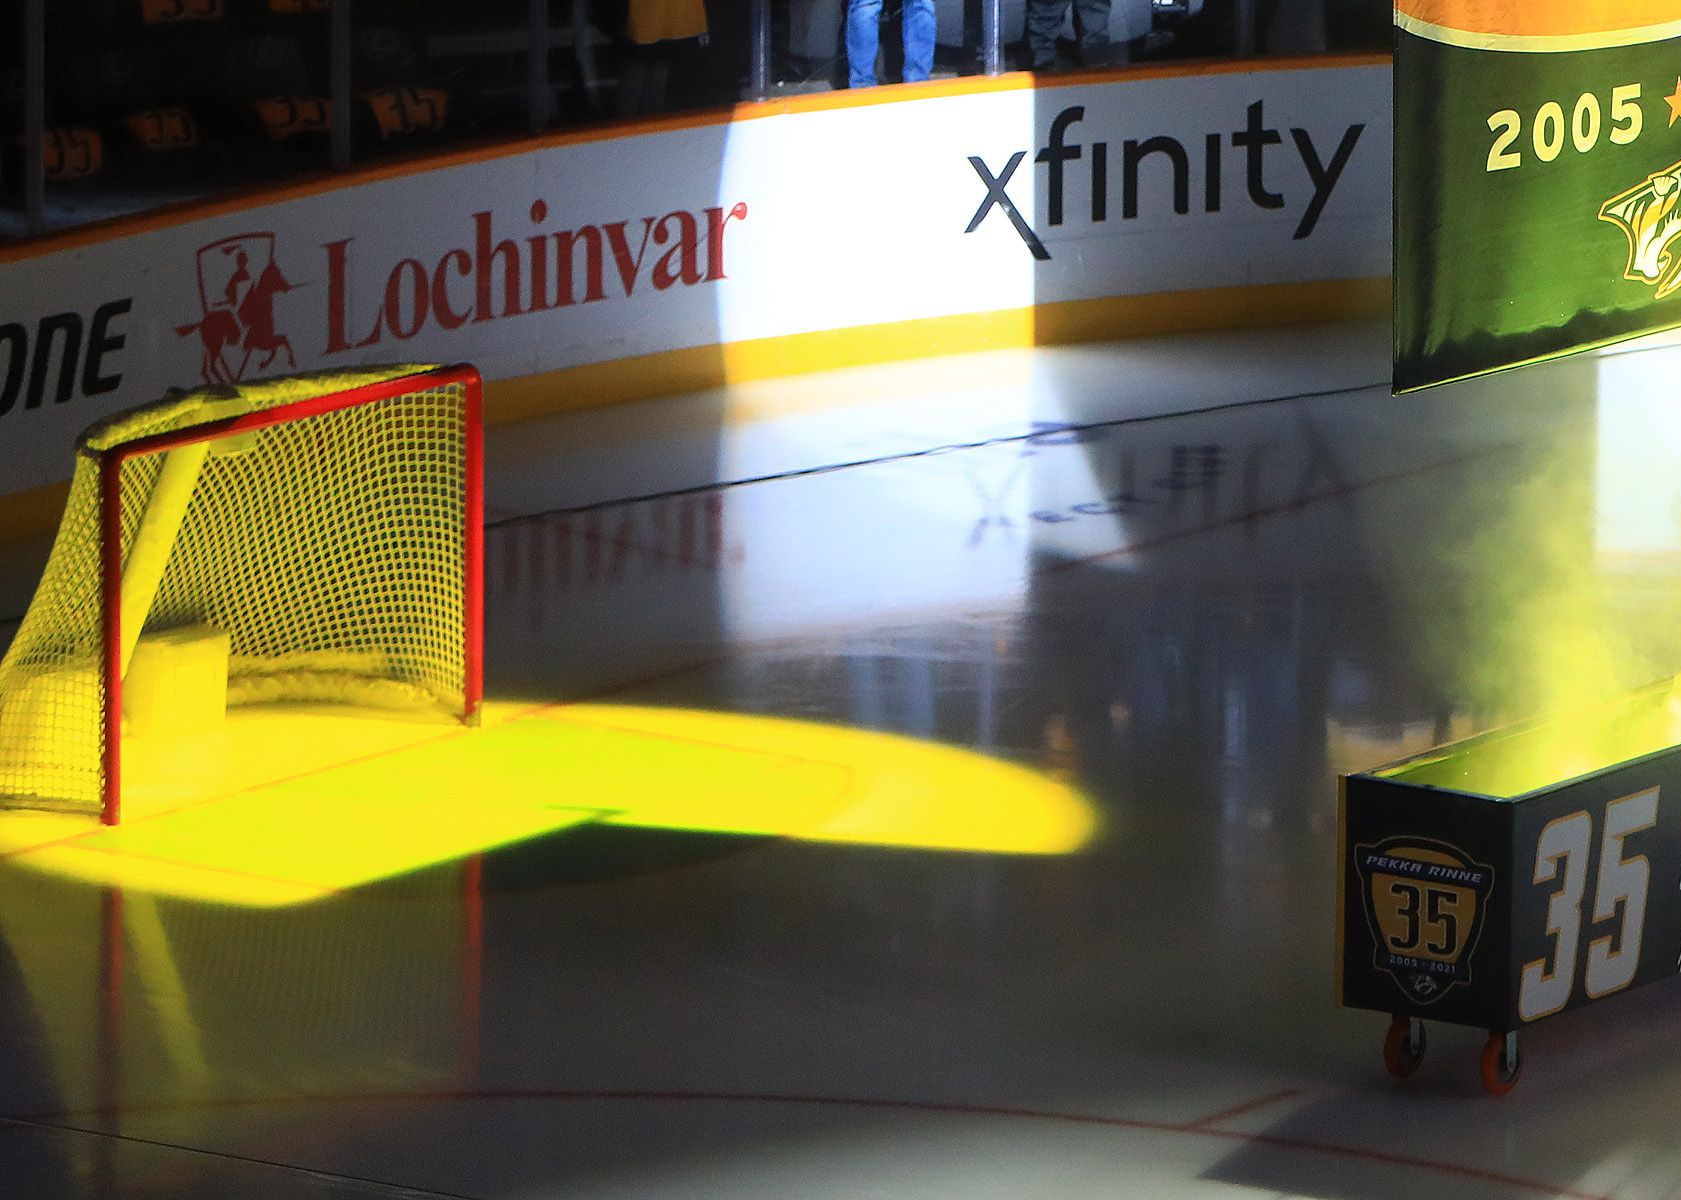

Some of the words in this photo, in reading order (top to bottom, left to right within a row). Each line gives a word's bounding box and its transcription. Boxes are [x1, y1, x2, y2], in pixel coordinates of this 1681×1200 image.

[1485, 82, 1643, 172] 2005
[964, 98, 1365, 261] xfinity
[320, 199, 748, 356] Lochinvar
[1366, 855, 1422, 873] PEKKA
[1428, 866, 1483, 884] RINNE
[1517, 784, 1661, 1022] 35
[1388, 882, 1459, 957] 35
[1390, 957, 1418, 969] 2005
[1429, 963, 1457, 975] 2021
